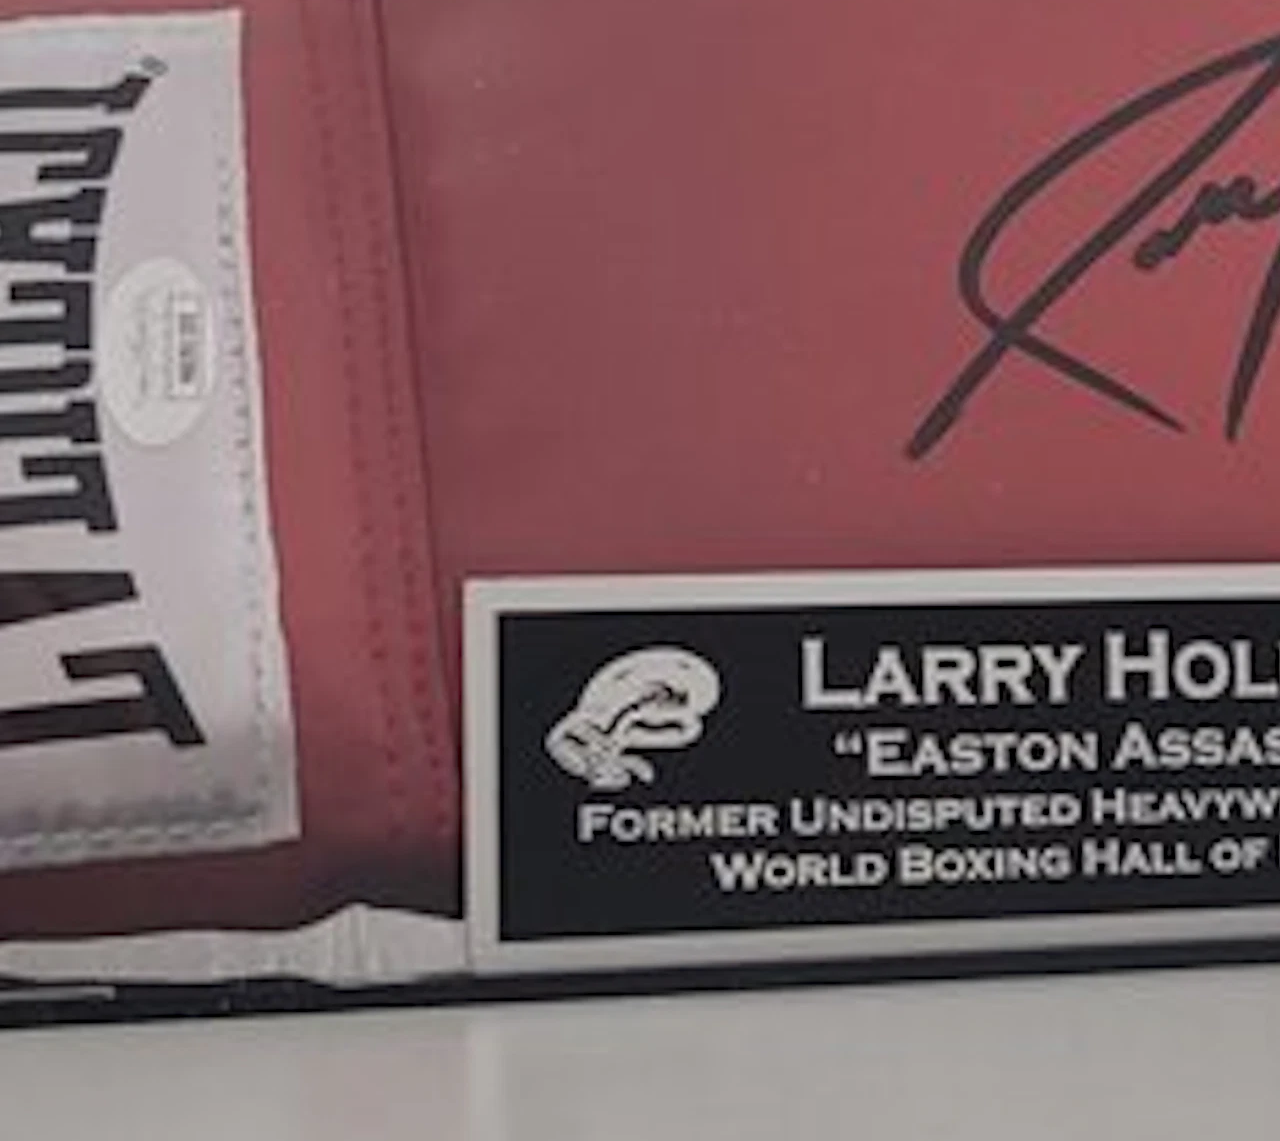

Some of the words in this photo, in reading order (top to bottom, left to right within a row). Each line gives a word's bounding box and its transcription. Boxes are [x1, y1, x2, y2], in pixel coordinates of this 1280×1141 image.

[800, 636, 1083, 710] LARRY
[576, 801, 778, 842] FORMER
[789, 793, 1081, 836] UNDISPUTED
[710, 851, 888, 892] WORLD
[898, 844, 1072, 886] BOXING
[1082, 837, 1202, 877] HALL
[1209, 837, 1269, 872] OF
